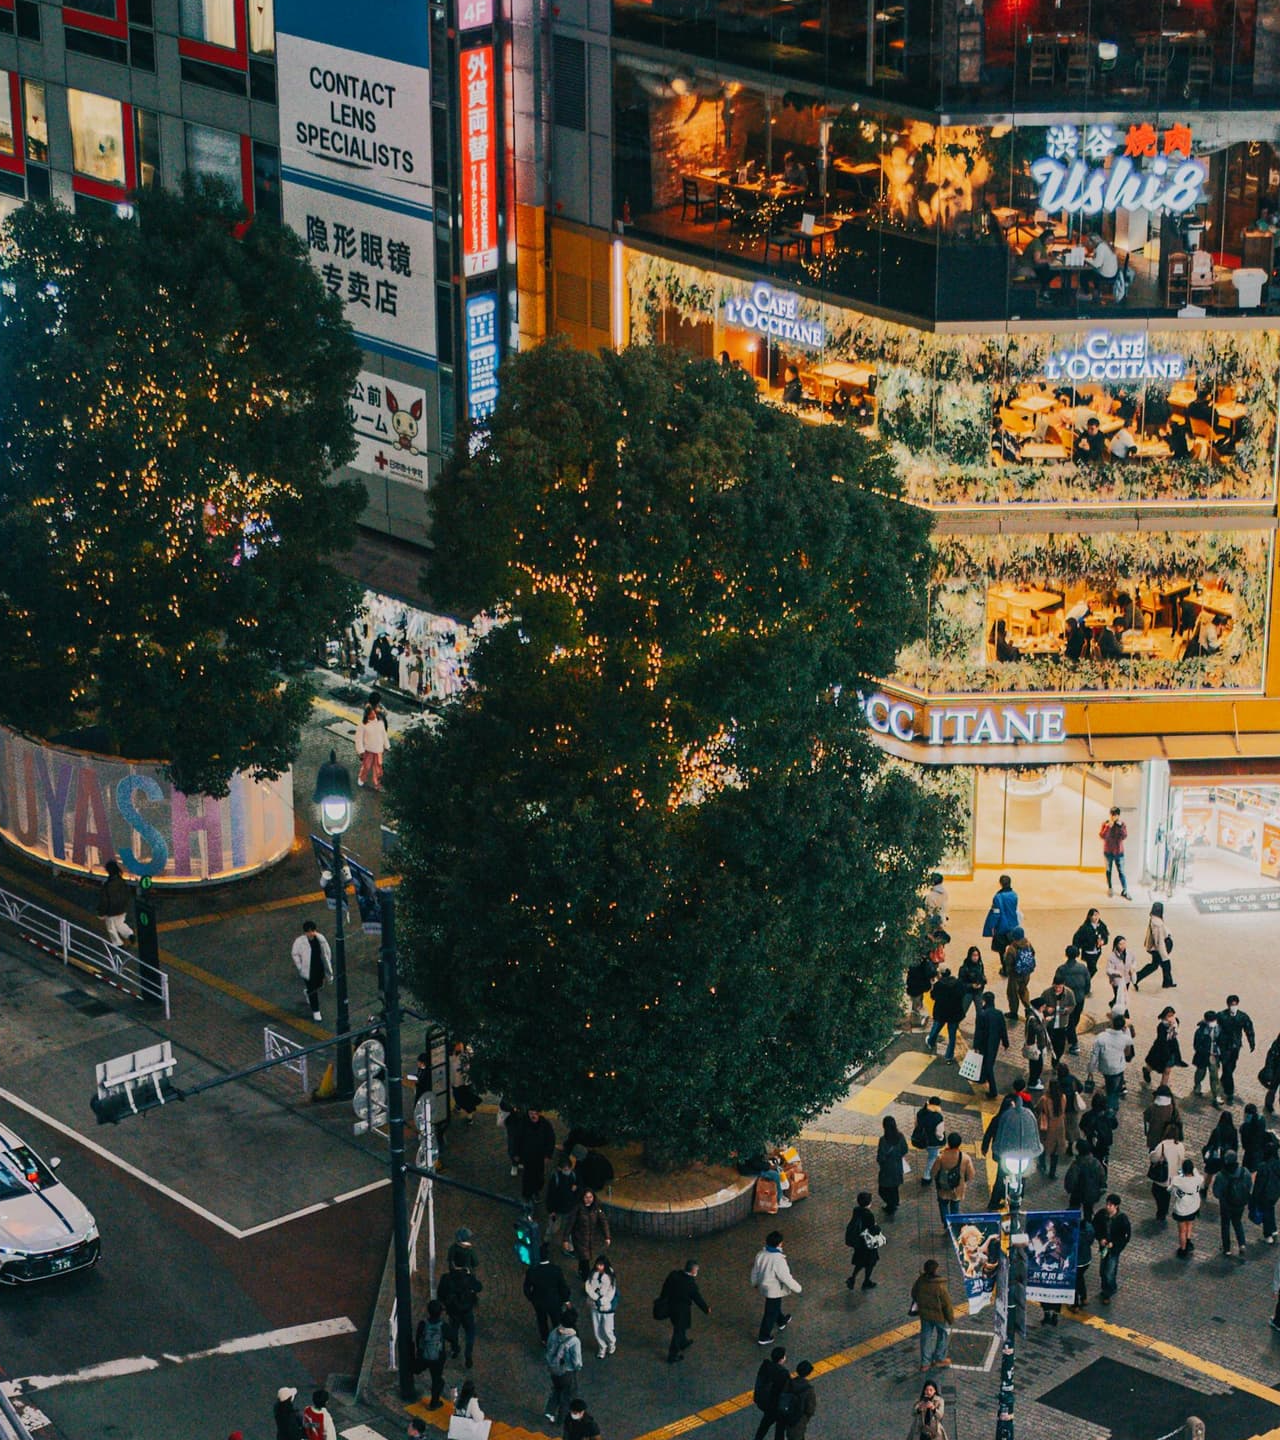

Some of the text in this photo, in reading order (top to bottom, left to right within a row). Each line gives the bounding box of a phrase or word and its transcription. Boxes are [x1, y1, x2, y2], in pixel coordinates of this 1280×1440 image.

[463, 0, 486, 22] 4F
[310, 66, 396, 109] CONTACT
[467, 51, 489, 161] 外貨両替
[330, 101, 376, 135] LENS
[296, 122, 415, 174] SPECIALISTS
[1031, 155, 1205, 216] Ushi8
[306, 213, 412, 278] 隐形眼镜
[727, 302, 823, 347] L'OCCITANE
[1046, 354, 1183, 380] L'OCCITANE
[858, 694, 1067, 746] CCITANE
